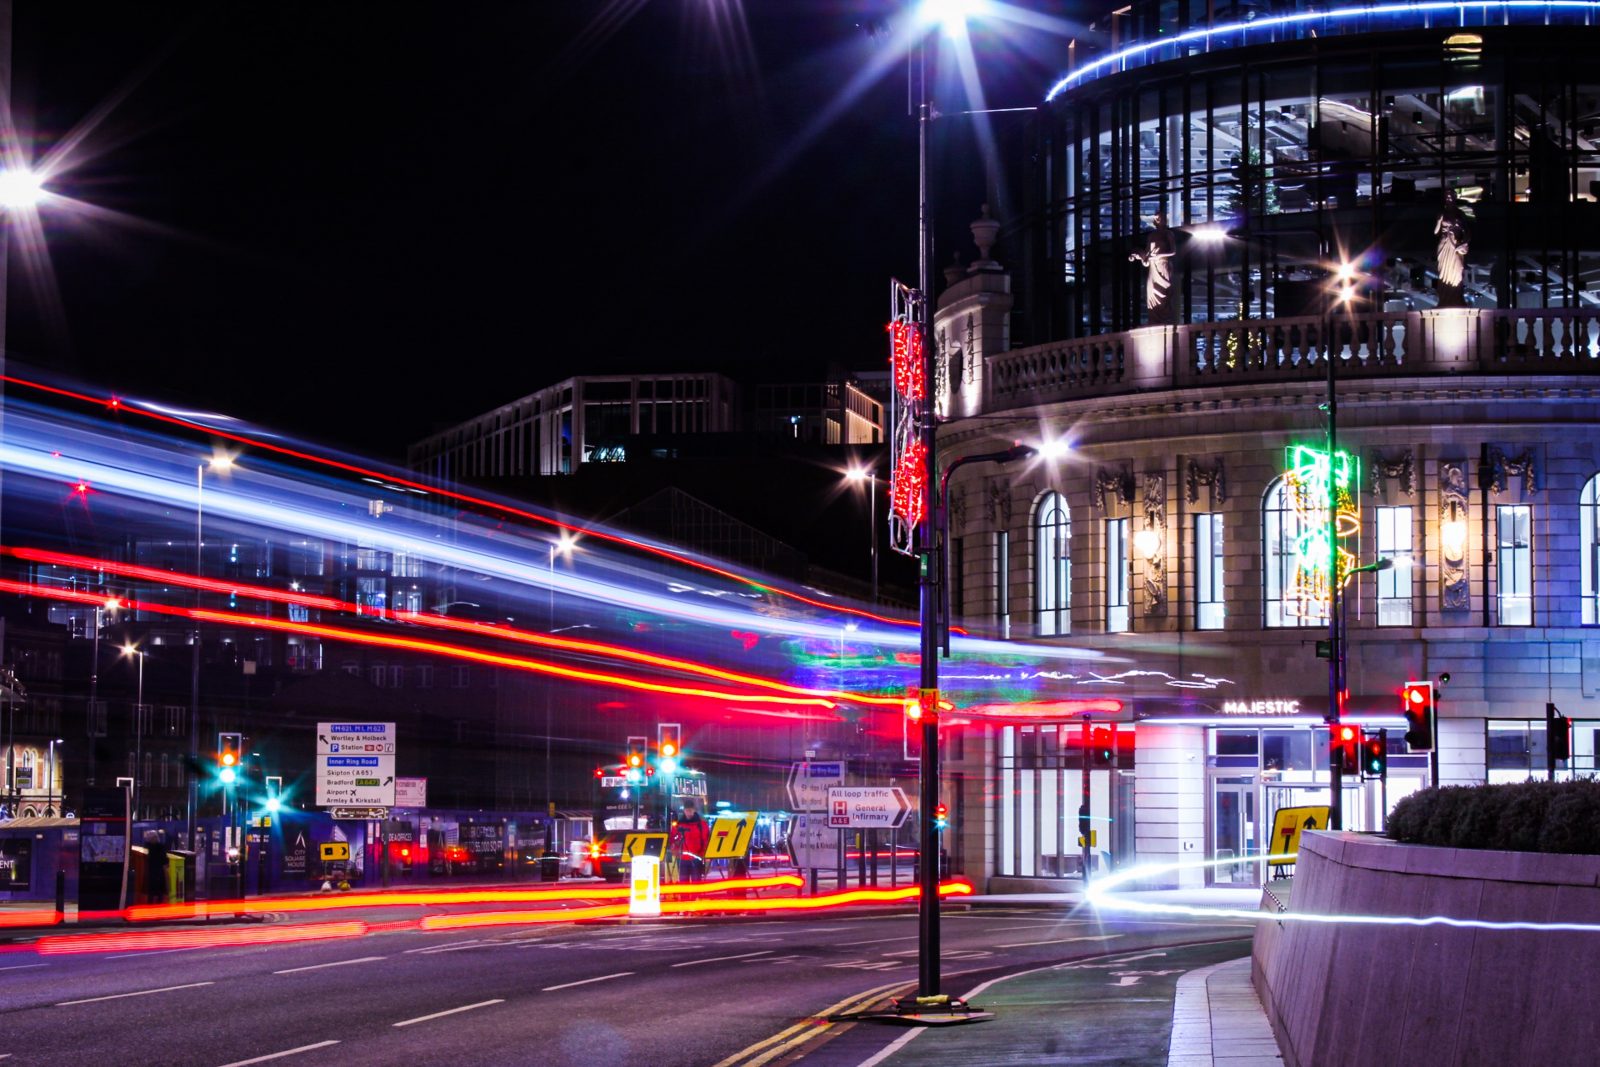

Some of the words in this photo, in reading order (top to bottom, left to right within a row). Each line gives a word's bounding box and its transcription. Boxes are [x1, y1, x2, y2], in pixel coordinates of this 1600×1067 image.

[1224, 700, 1299, 714] MAJESTIC
[844, 790, 861, 798] loop
[855, 804, 886, 812] General
[852, 813, 889, 821] Infirmary
